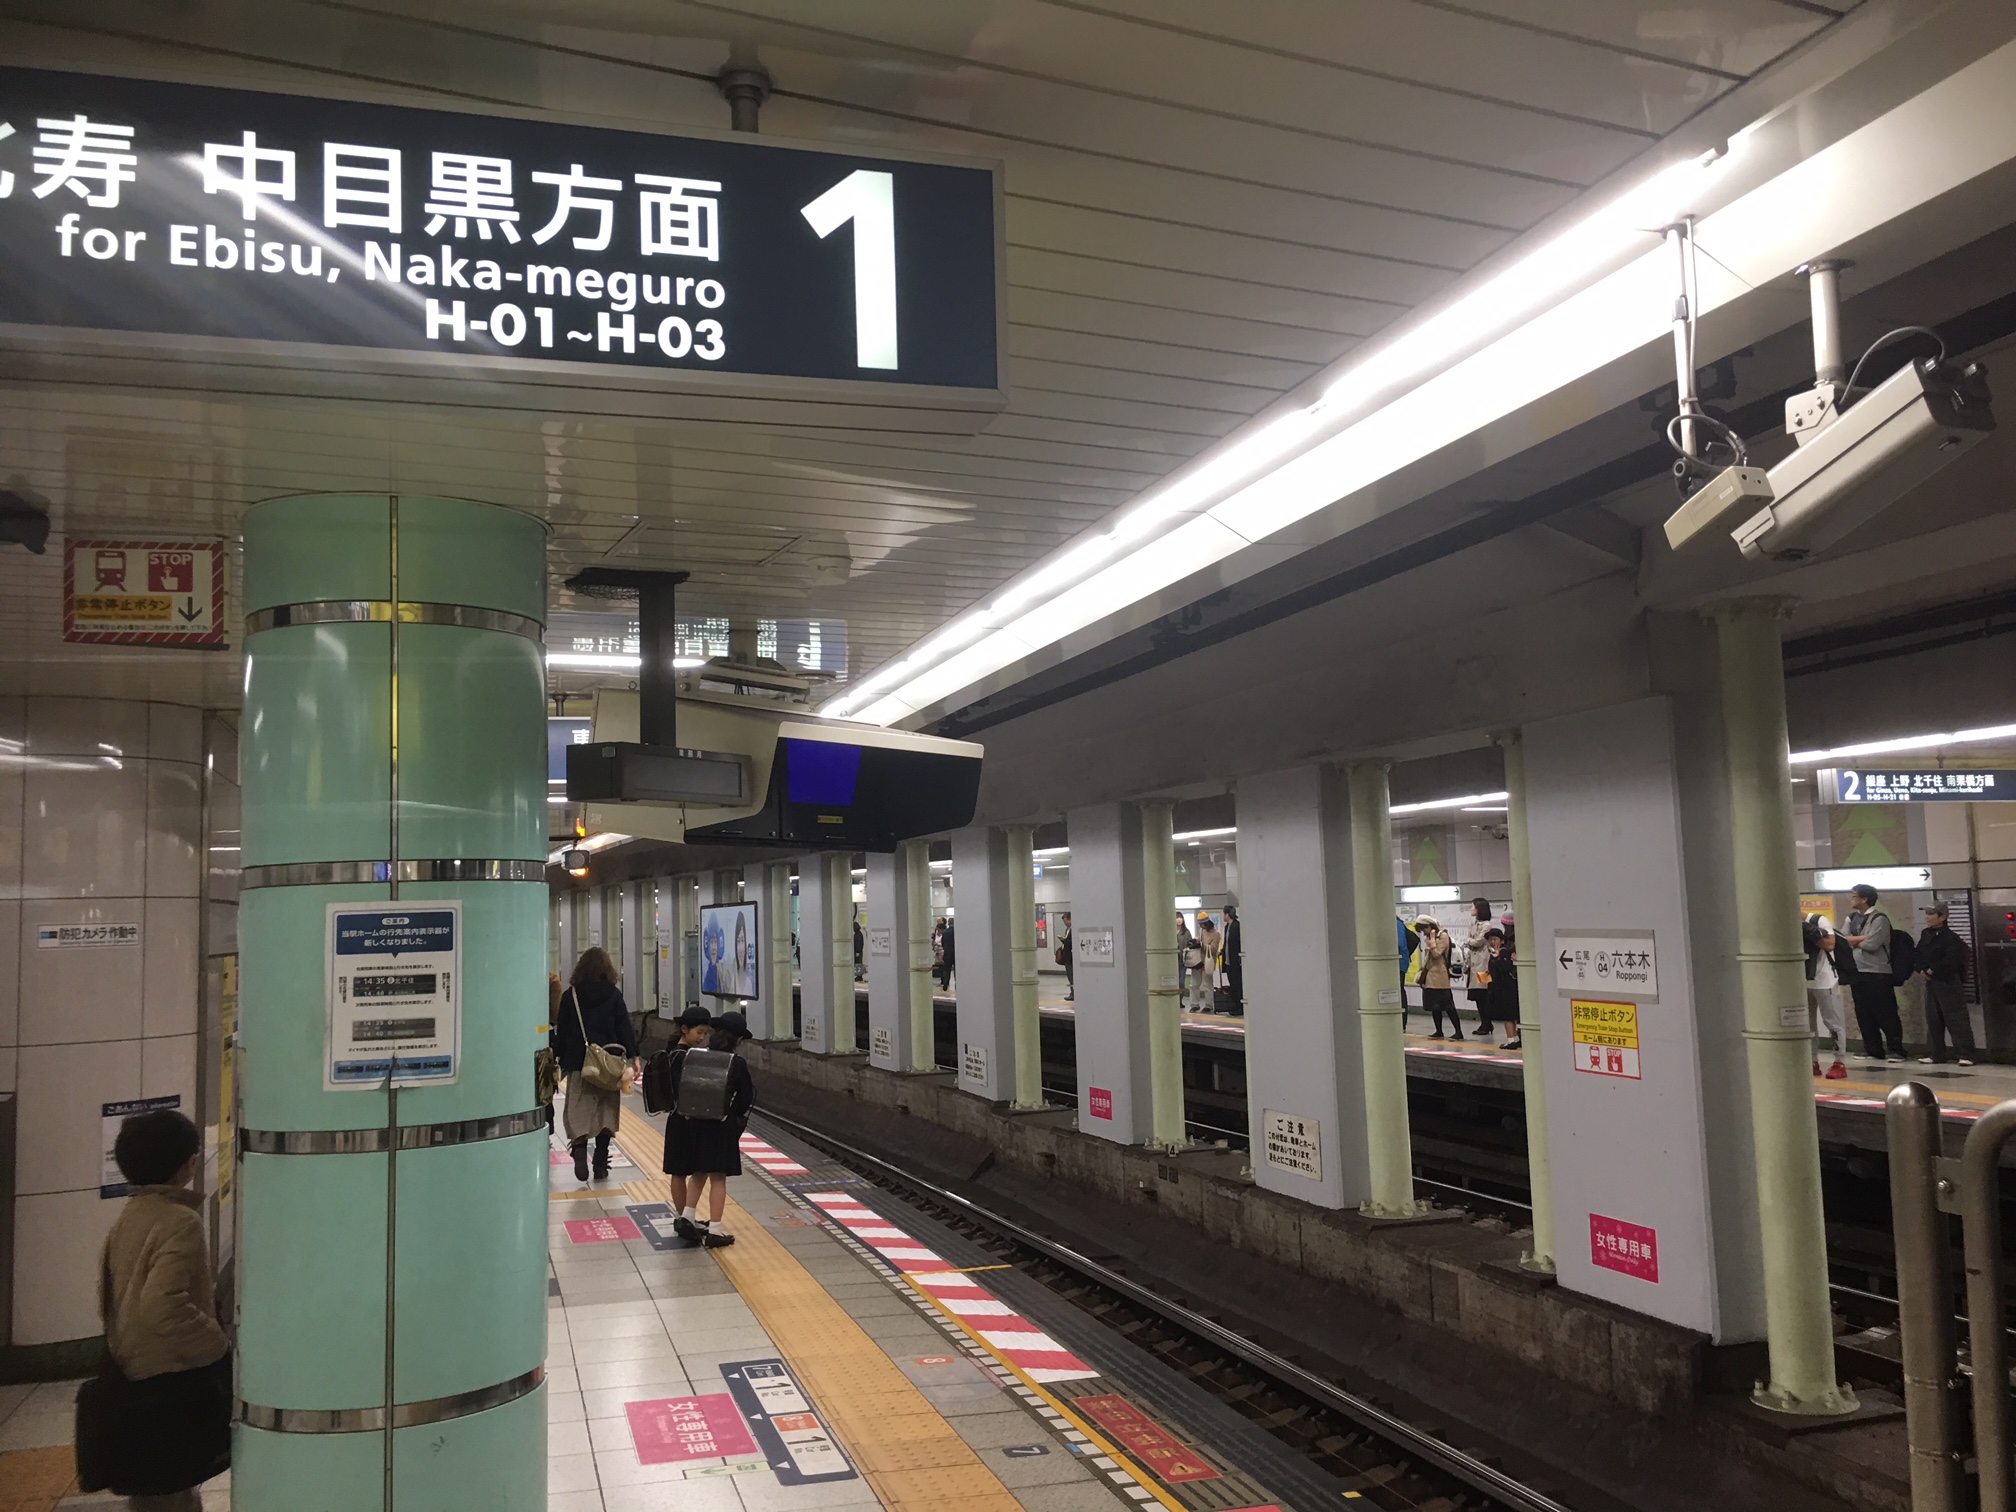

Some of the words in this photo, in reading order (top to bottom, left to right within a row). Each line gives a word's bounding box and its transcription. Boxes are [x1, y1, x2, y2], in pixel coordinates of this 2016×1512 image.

[0, 115, 137, 209] 寿
[203, 130, 722, 262] 中目黒方面
[55, 213, 147, 262] for
[169, 224, 341, 285] Ebisu,
[363, 240, 727, 313] Naka-meguro
[800, 168, 898, 371] 1
[150, 553, 192, 565] STOP
[76, 598, 171, 612] 非常停止ボタン
[1843, 770, 1861, 800] 2
[1866, 774, 1887, 788] 銀座
[1890, 774, 1910, 787] 上野
[1913, 774, 1943, 787] 北千住
[60, 926, 138, 940] 防犯カメラ作動中
[1599, 954, 1605, 962] H
[1611, 950, 1651, 970] 六本木
[1597, 963, 1609, 973] 04
[1615, 970, 1648, 983] Roppongi
[1574, 1006, 1634, 1023] 非常停止ボタン
[1607, 1048, 1622, 1057] STOP
[1277, 1119, 1305, 1136] ご注意
[1169, 1145, 1175, 1156] 4
[1595, 1231, 1652, 1260] 女性専用車
[667, 1401, 718, 1454] 女性専用車
